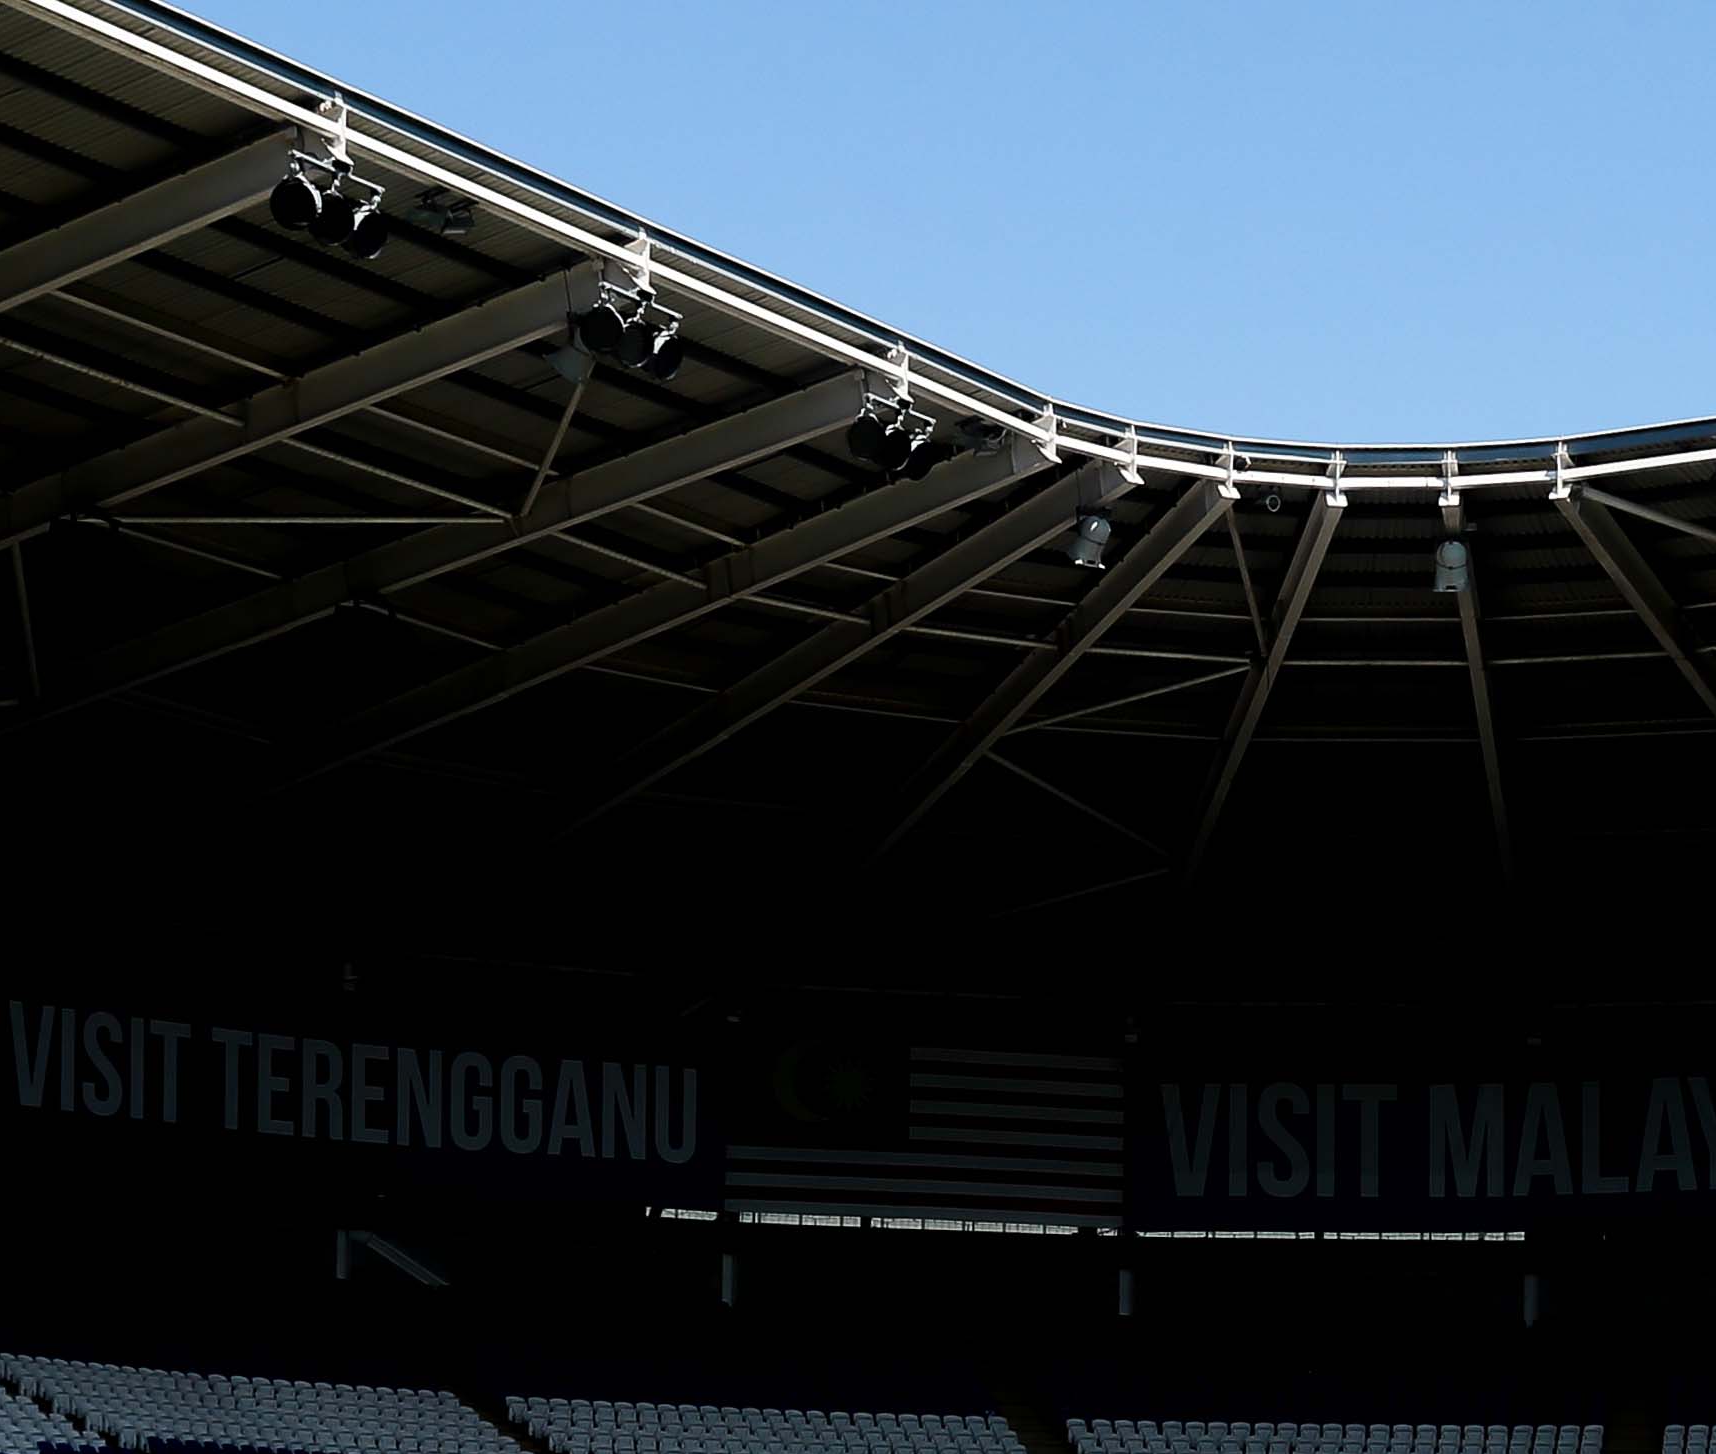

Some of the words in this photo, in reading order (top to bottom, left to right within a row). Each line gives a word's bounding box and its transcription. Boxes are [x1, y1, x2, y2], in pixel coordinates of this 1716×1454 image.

[9, 1000, 192, 1124] VISIT
[212, 1026, 701, 1165] TERENGGANU
[1158, 1080, 1399, 1199] VISIT
